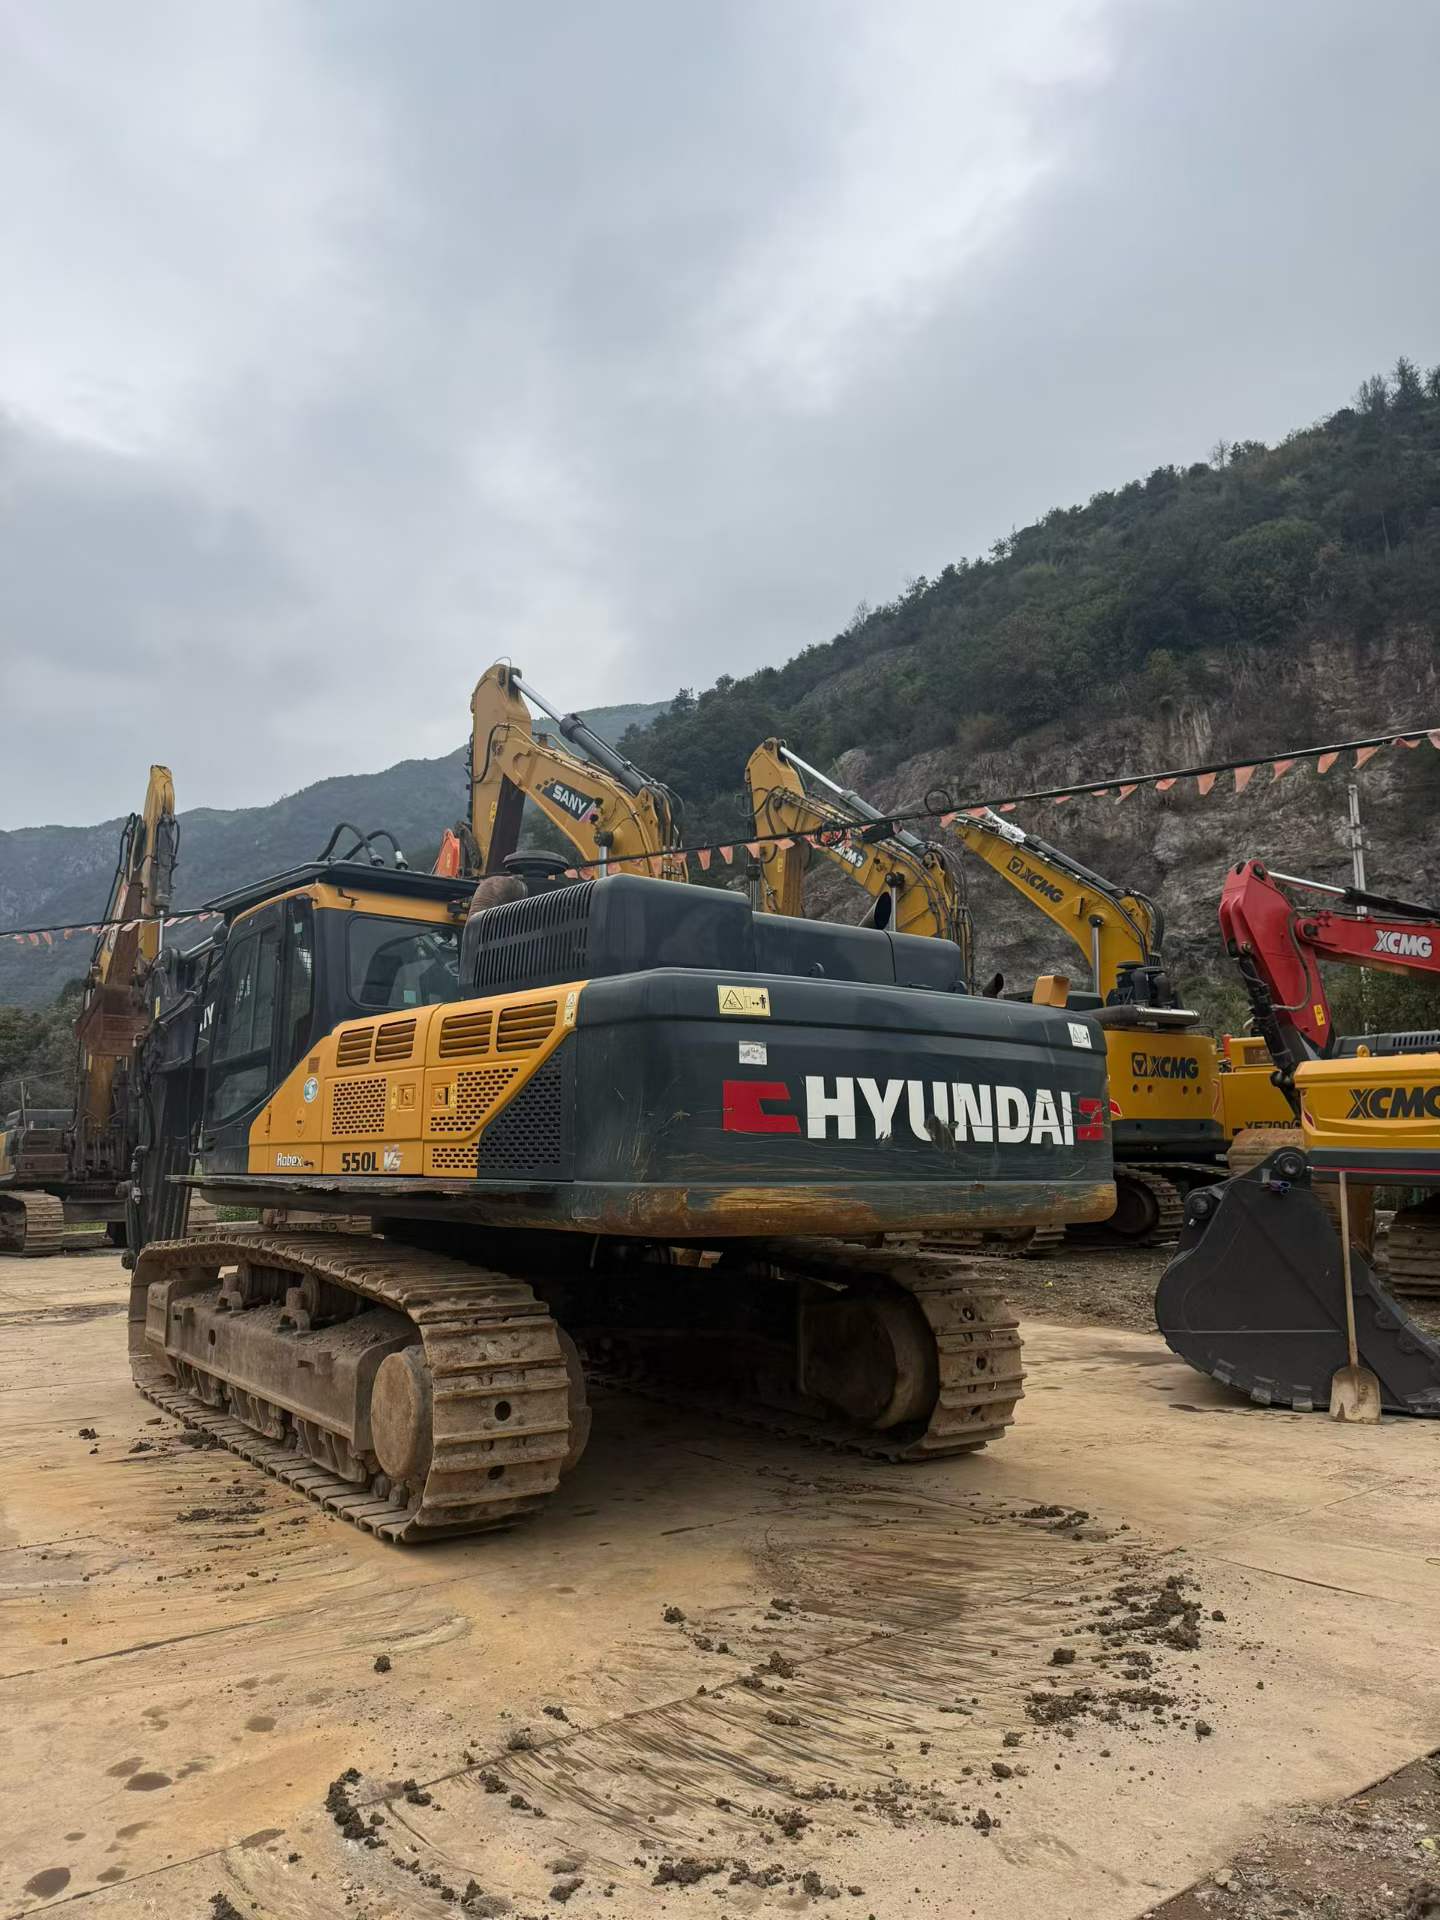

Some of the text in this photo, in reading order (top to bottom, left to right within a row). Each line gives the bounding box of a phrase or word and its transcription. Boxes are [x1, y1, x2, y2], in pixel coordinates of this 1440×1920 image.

[552, 785, 587, 814] SANY
[1020, 867, 1065, 903] XCMG
[1372, 929, 1433, 958] XCMG
[1147, 1055, 1199, 1079] XCMG
[805, 1075, 1076, 1146] HYUNDAI
[276, 1152, 304, 1168] Robex
[341, 1151, 379, 1172] 550L
